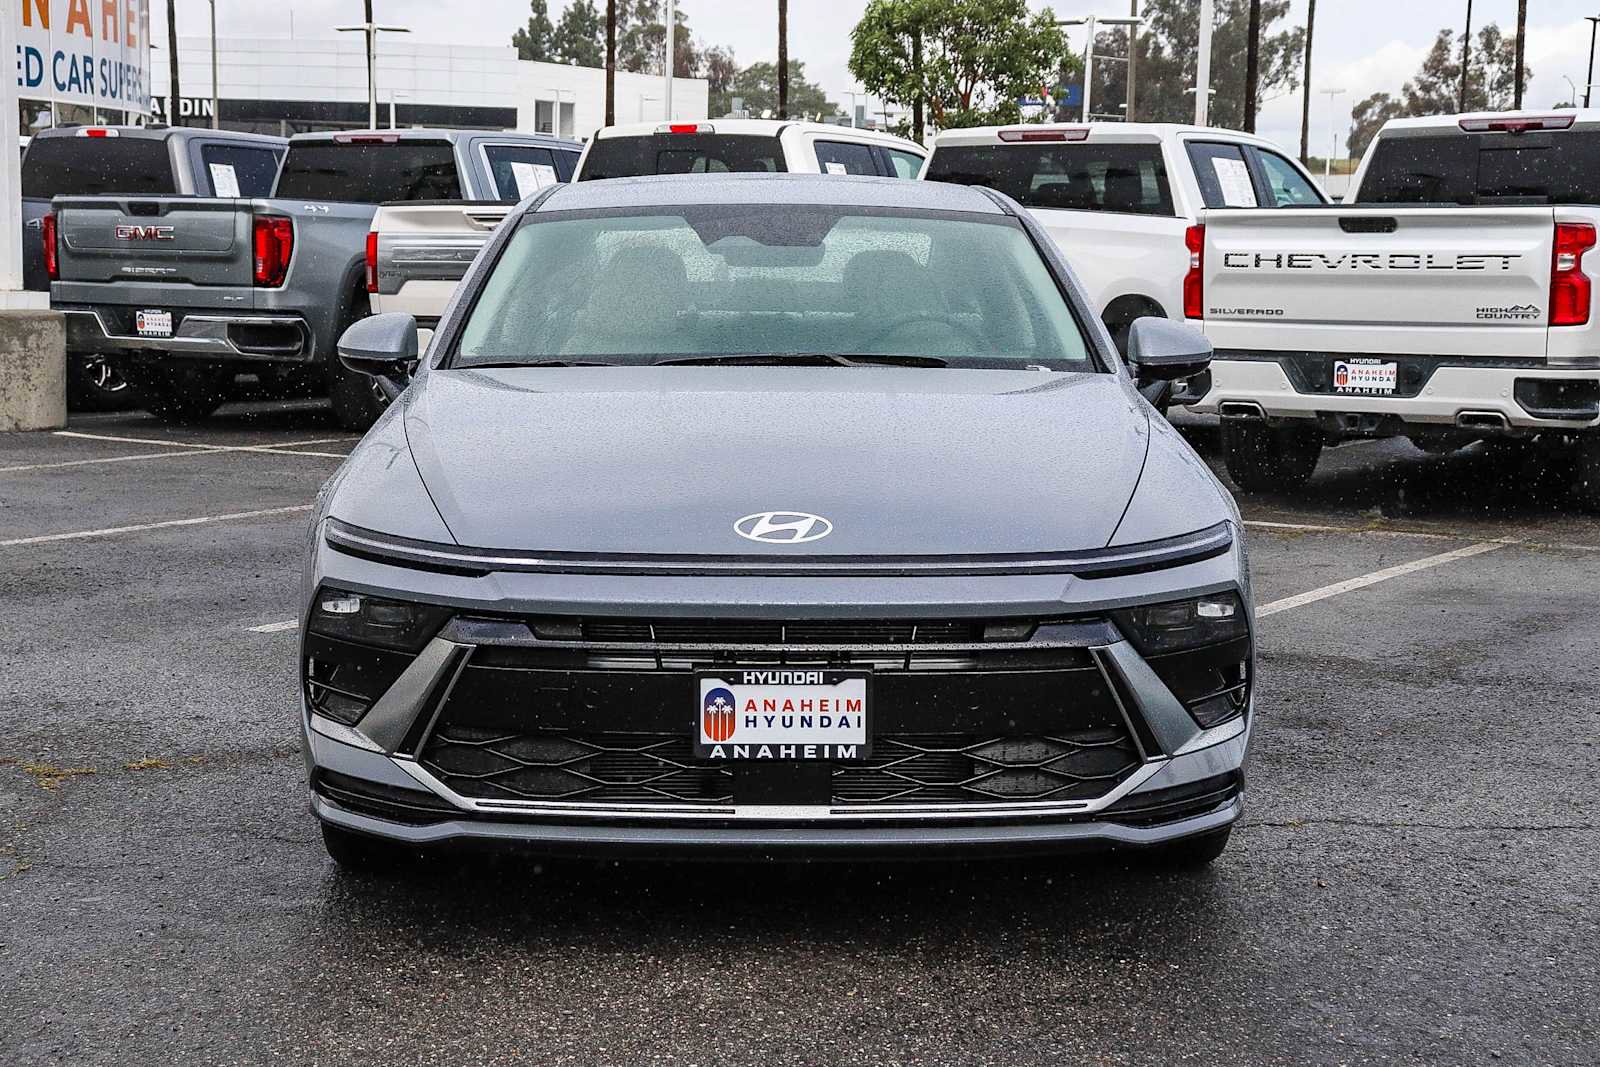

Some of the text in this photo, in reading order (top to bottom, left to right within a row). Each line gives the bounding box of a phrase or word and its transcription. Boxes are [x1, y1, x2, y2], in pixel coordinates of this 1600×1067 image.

[53, 50, 94, 95] CAR
[115, 225, 175, 241] GMC
[1224, 252, 1522, 271] CHEVROLET
[1209, 307, 1284, 316] SILVERADO
[1351, 375, 1395, 383] HYUNDAI
[1336, 387, 1393, 395] ANAHEIM
[743, 671, 824, 685] HYUNDAI
[745, 699, 862, 712] ANAHEIM
[745, 715, 861, 728] HYUNDAI
[709, 744, 857, 759] ANAHEIM
